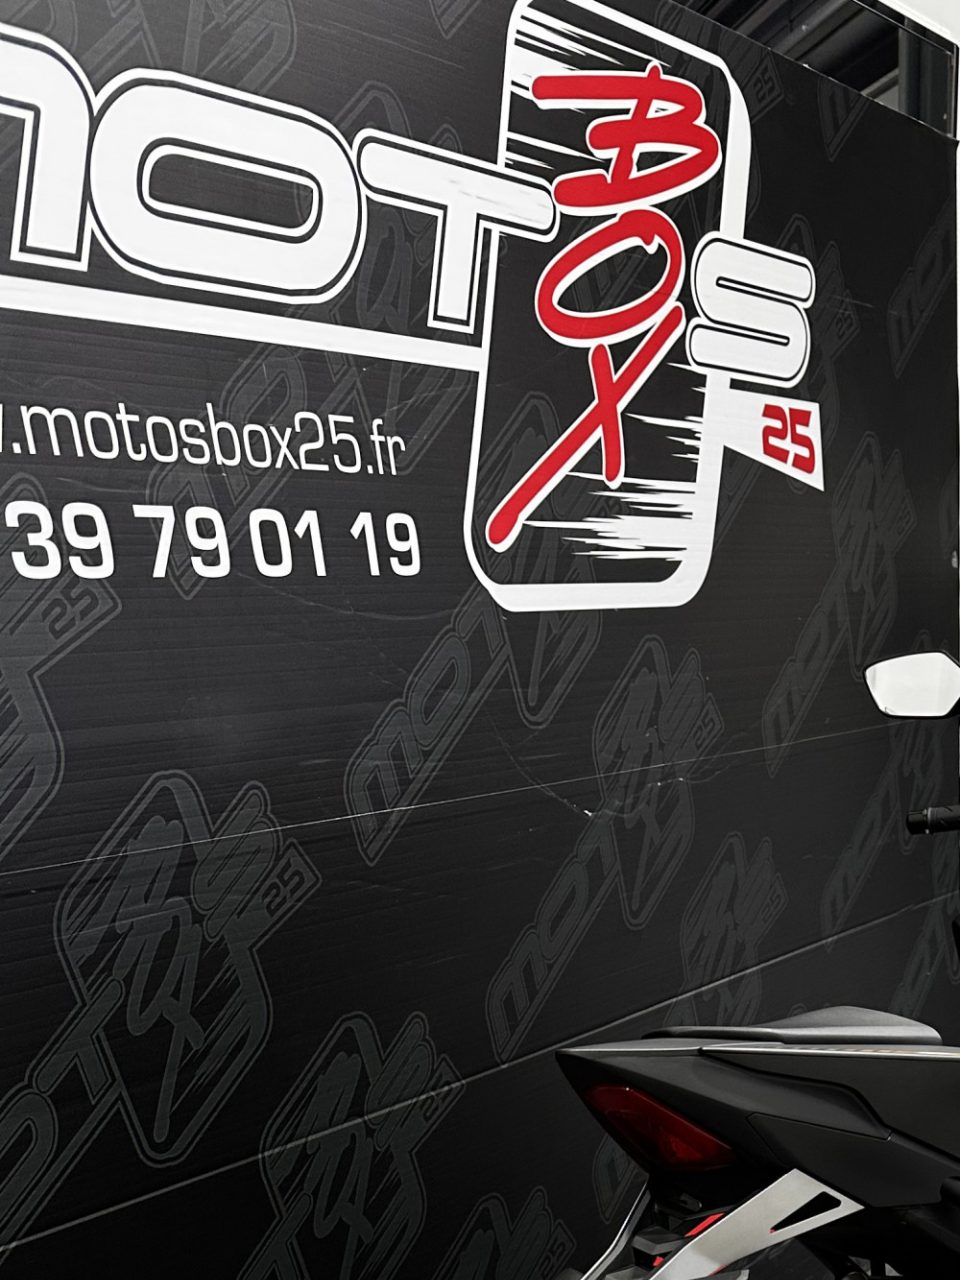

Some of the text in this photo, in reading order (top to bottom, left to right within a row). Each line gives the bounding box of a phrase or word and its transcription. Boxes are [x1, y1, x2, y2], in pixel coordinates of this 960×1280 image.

[762, 404, 817, 476] 25
[5, 500, 421, 580] 39 79 01 19
